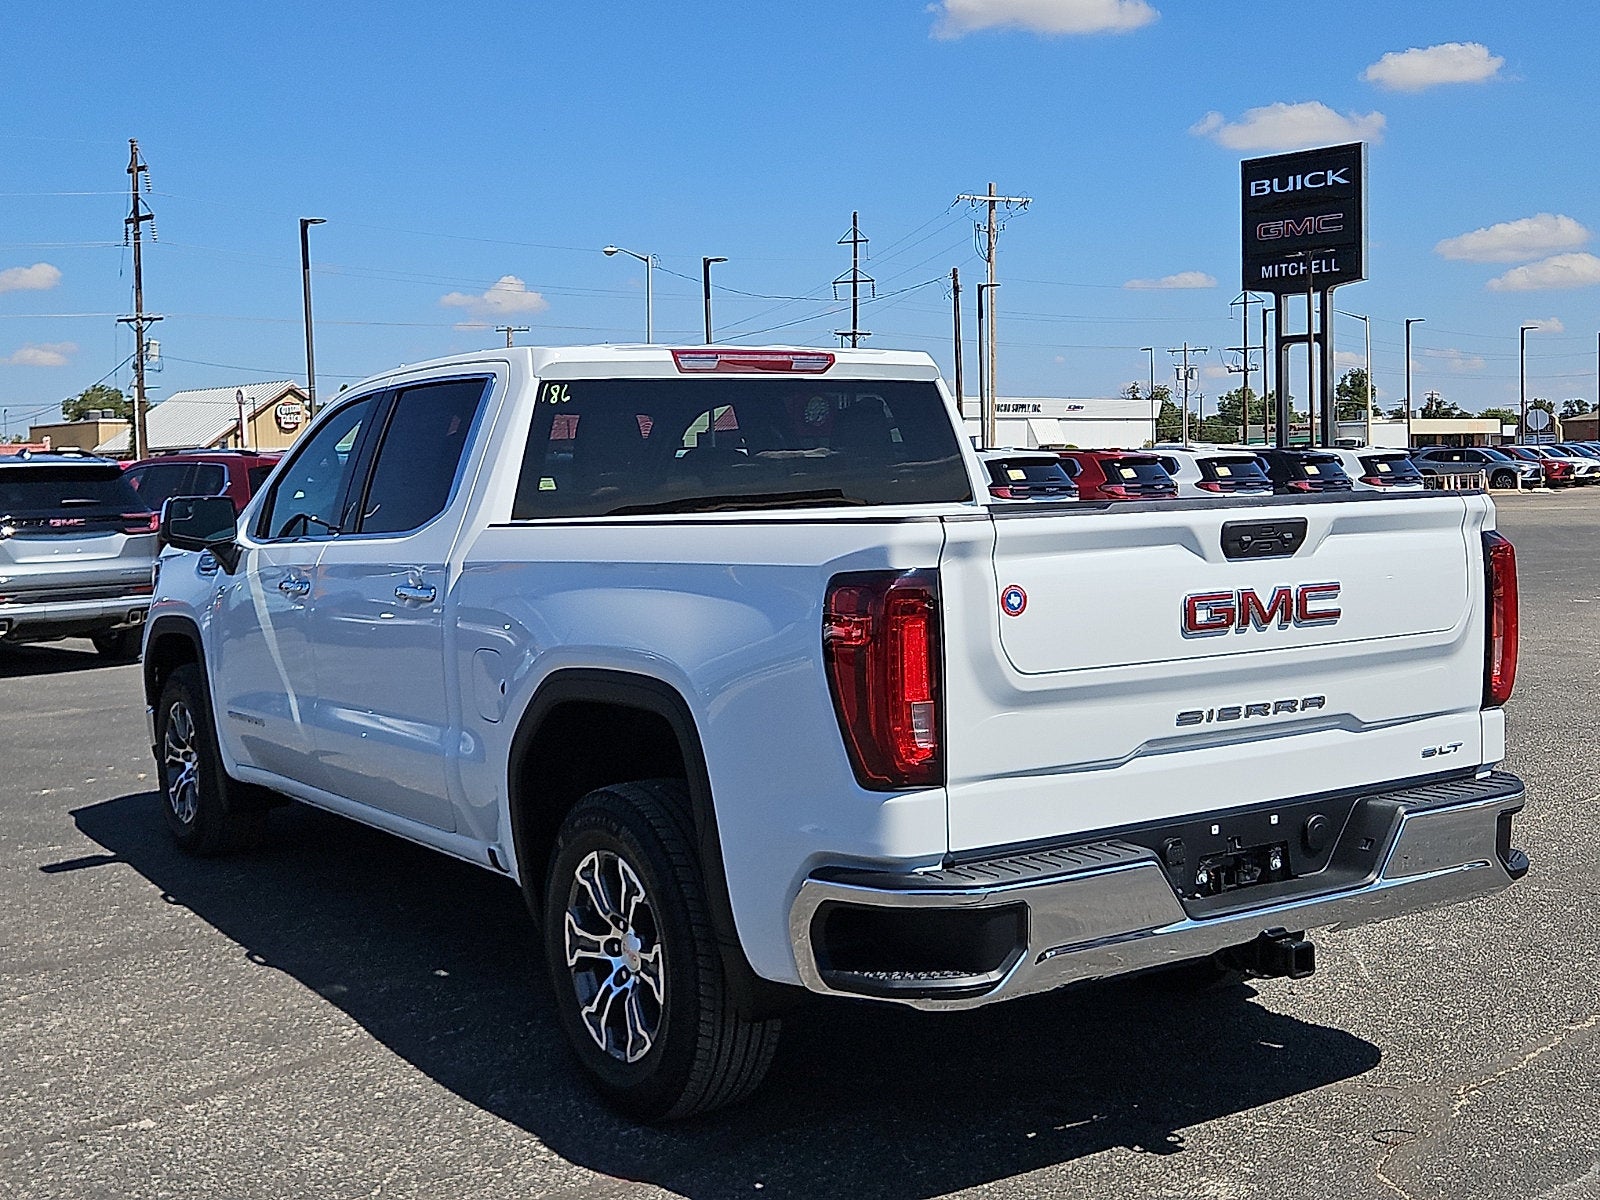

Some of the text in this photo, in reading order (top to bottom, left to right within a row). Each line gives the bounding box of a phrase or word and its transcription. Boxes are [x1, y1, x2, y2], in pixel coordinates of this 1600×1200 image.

[1250, 167, 1351, 197] BUICK
[1256, 213, 1343, 240] GMC
[1261, 258, 1340, 279] MITCHELL
[541, 383, 571, 404] 186
[50, 518, 87, 527] GMC
[1181, 581, 1341, 639] GMC
[1176, 695, 1326, 726] SIERRA
[1421, 742, 1463, 759] SLT
